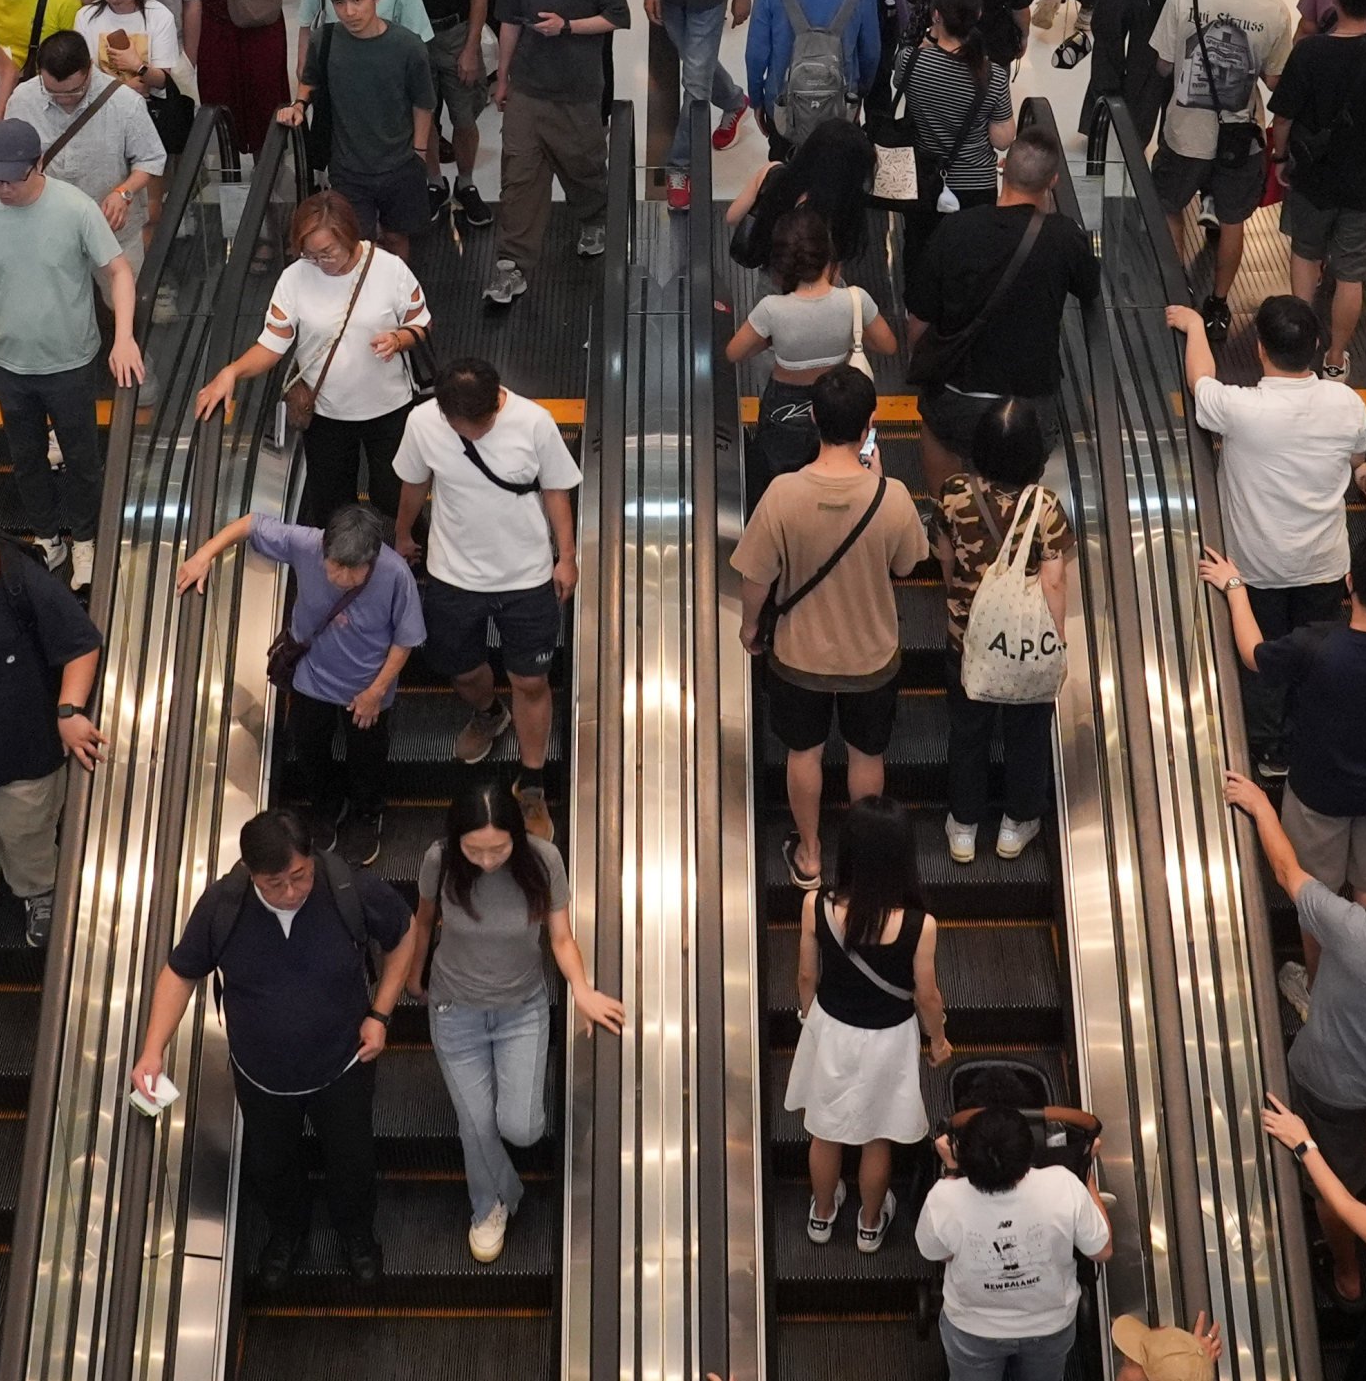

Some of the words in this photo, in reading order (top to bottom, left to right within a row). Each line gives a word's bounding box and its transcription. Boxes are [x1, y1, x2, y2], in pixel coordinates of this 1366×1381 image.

[1215, 12, 1265, 32] Strauss
[988, 631, 1062, 661] A.P.C.
[1004, 1276, 1041, 1289] BALANCE
